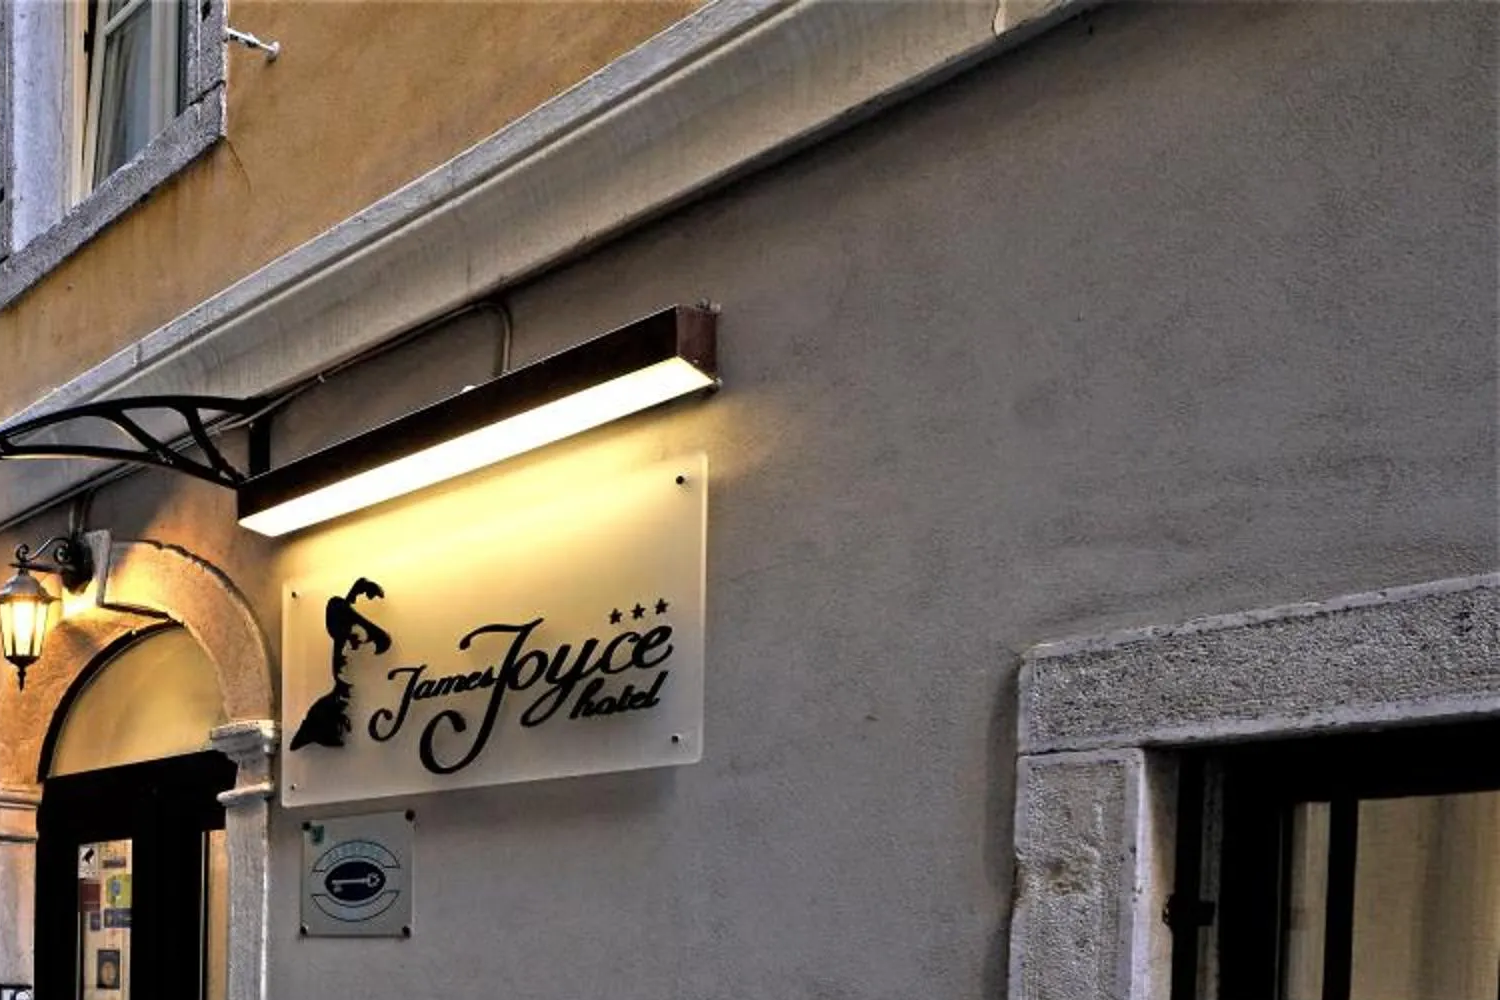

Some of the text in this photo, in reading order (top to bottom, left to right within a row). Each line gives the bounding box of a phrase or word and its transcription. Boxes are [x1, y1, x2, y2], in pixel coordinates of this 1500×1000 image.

[368, 618, 674, 774] James Joyce
[569, 671, 668, 719] hotel
